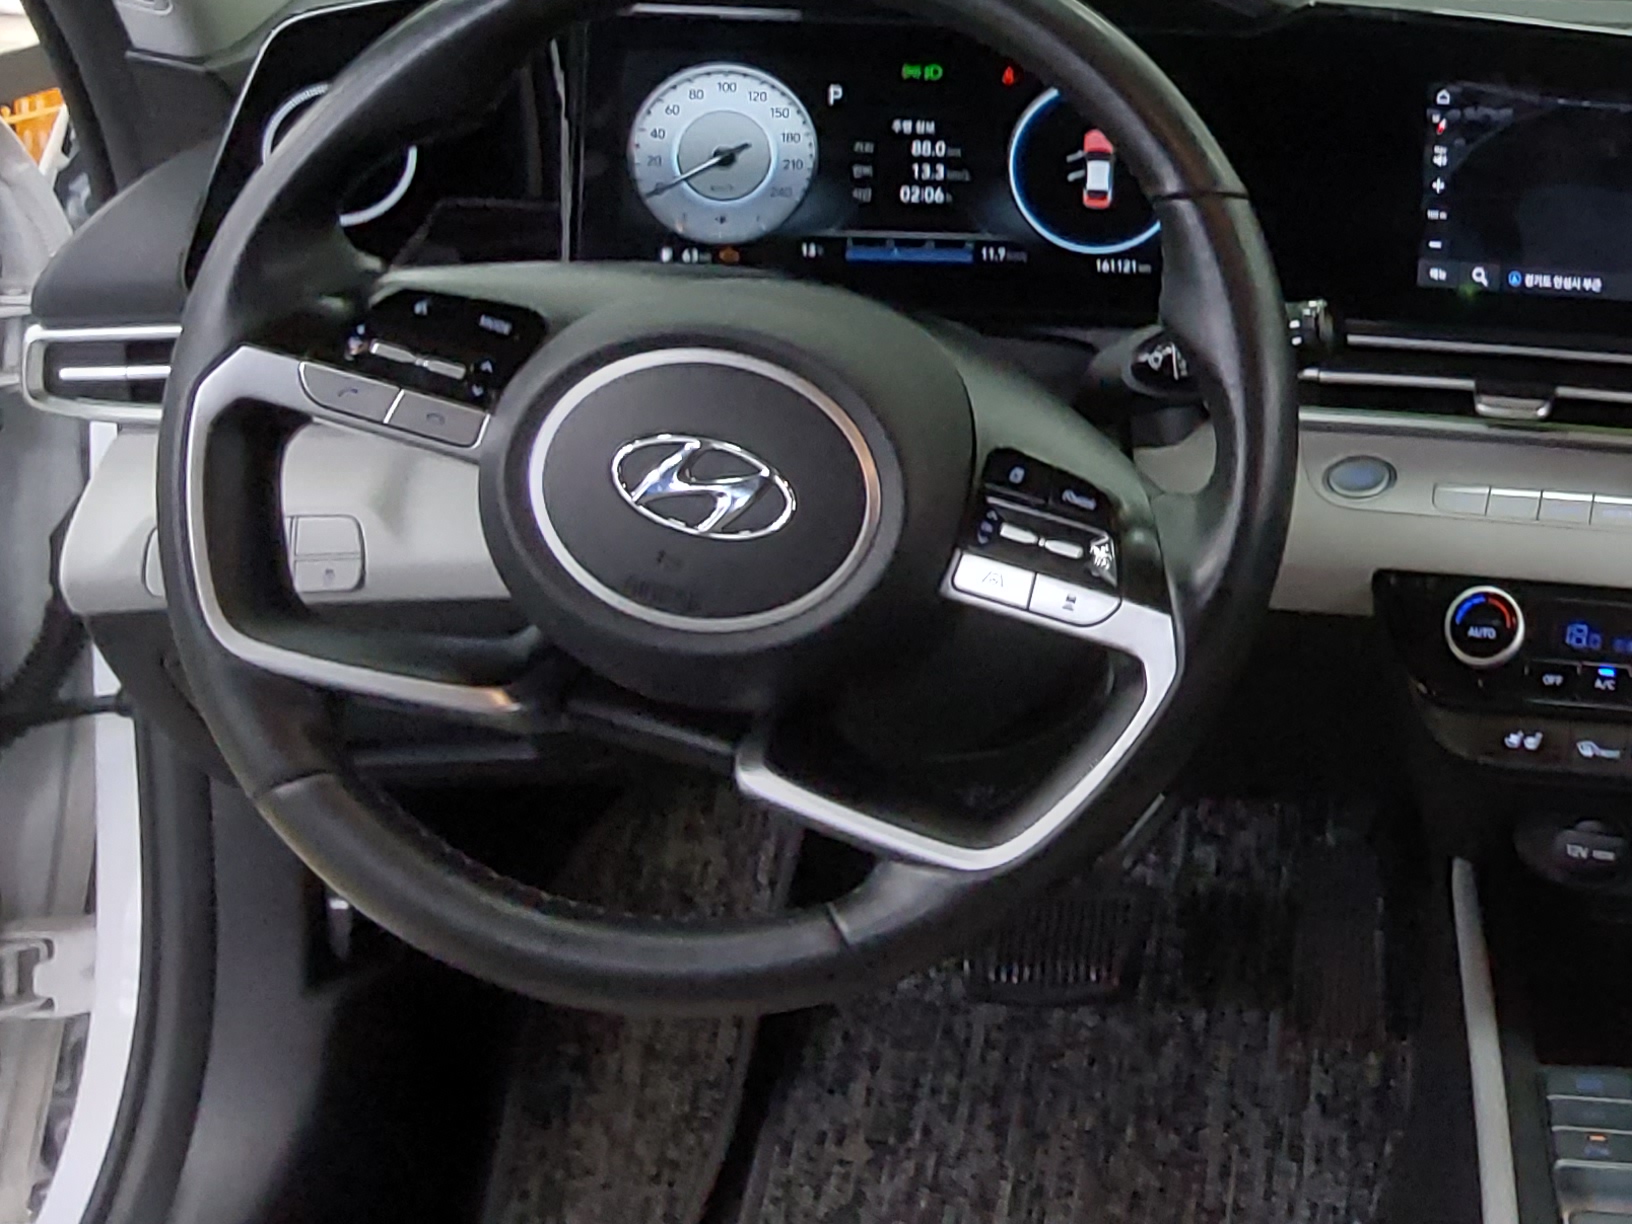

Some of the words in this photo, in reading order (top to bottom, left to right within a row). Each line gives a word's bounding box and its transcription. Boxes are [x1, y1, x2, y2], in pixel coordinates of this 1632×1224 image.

[717, 81, 737, 92] 100
[688, 89, 704, 101] 80
[748, 91, 768, 102] 120
[829, 83, 843, 106] P
[665, 104, 680, 116] 60
[770, 107, 790, 119] 150
[650, 129, 666, 140] 40
[782, 132, 801, 143] 180
[647, 155, 663, 167] 20
[783, 160, 804, 171] 210
[912, 162, 945, 181] 13.3
[770, 186, 793, 198] 240
[900, 184, 945, 204] 02:06
[1467, 626, 1497, 640] AUTO
[1542, 674, 1564, 687] OFF
